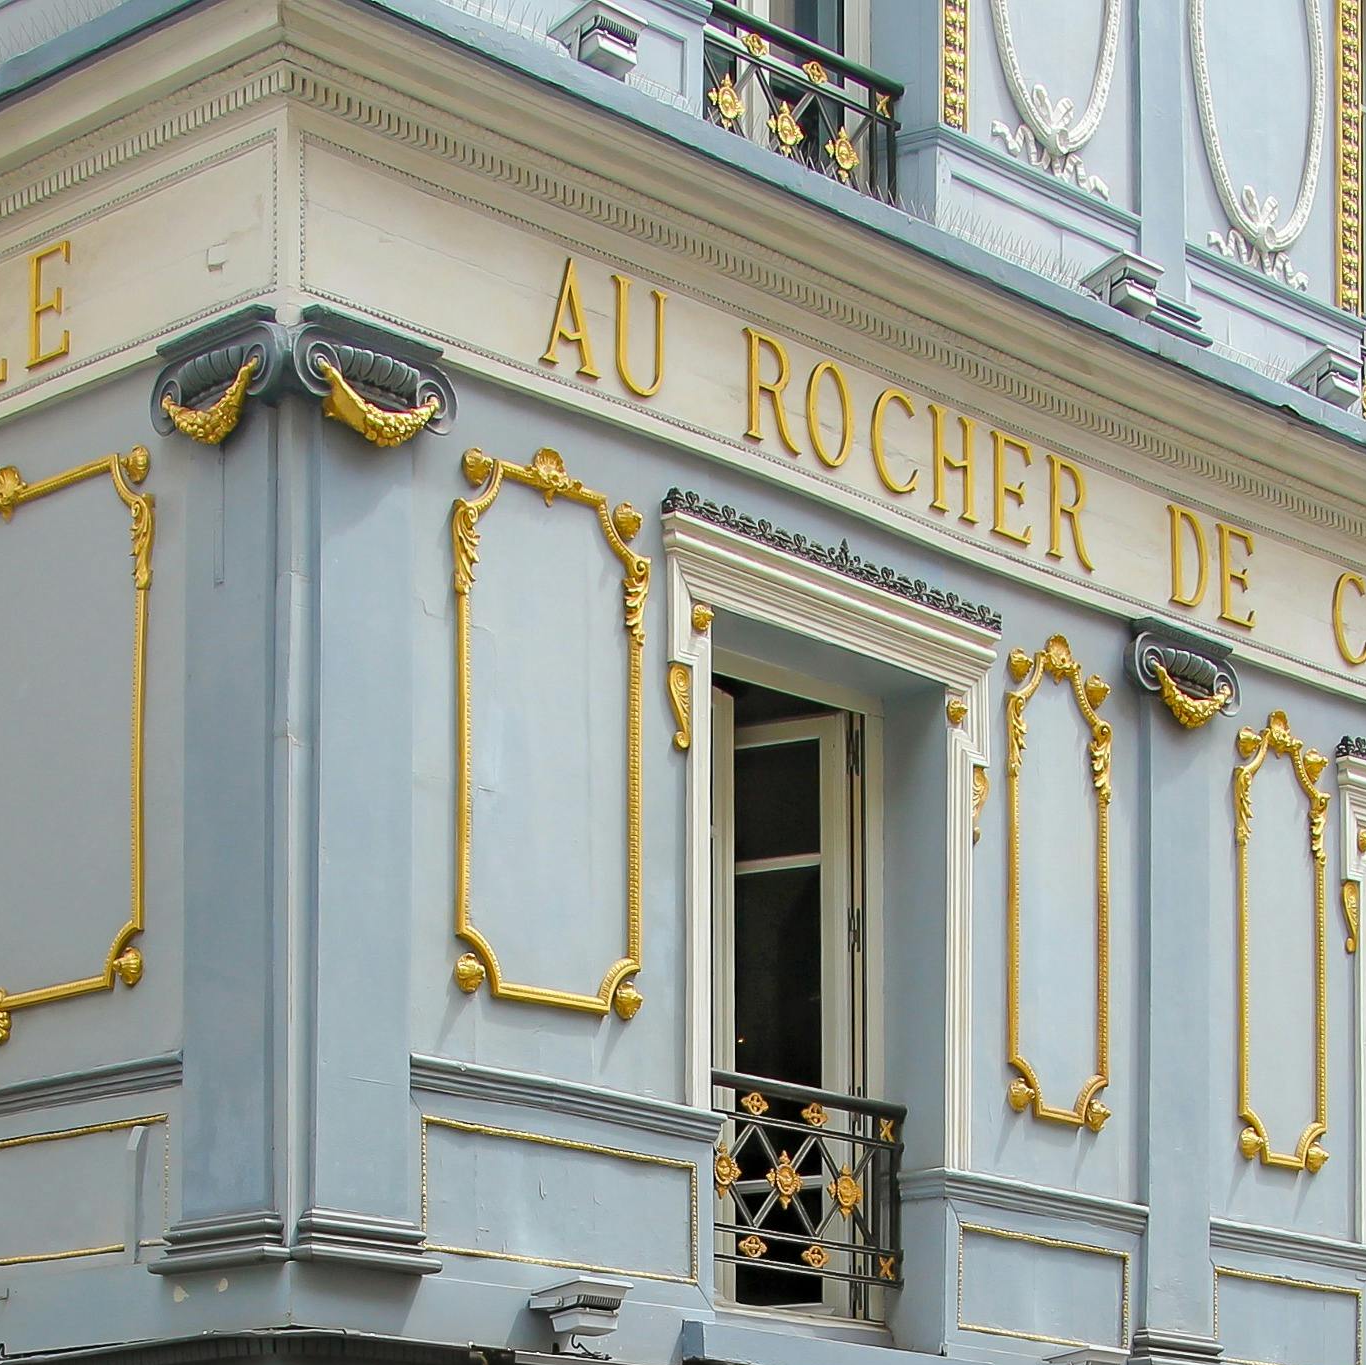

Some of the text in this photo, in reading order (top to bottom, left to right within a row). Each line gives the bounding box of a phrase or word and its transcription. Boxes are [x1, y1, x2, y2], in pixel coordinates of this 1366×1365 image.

[540, 257, 667, 398] AU
[742, 327, 1094, 571] ROCHER
[1167, 504, 1256, 629] DE
